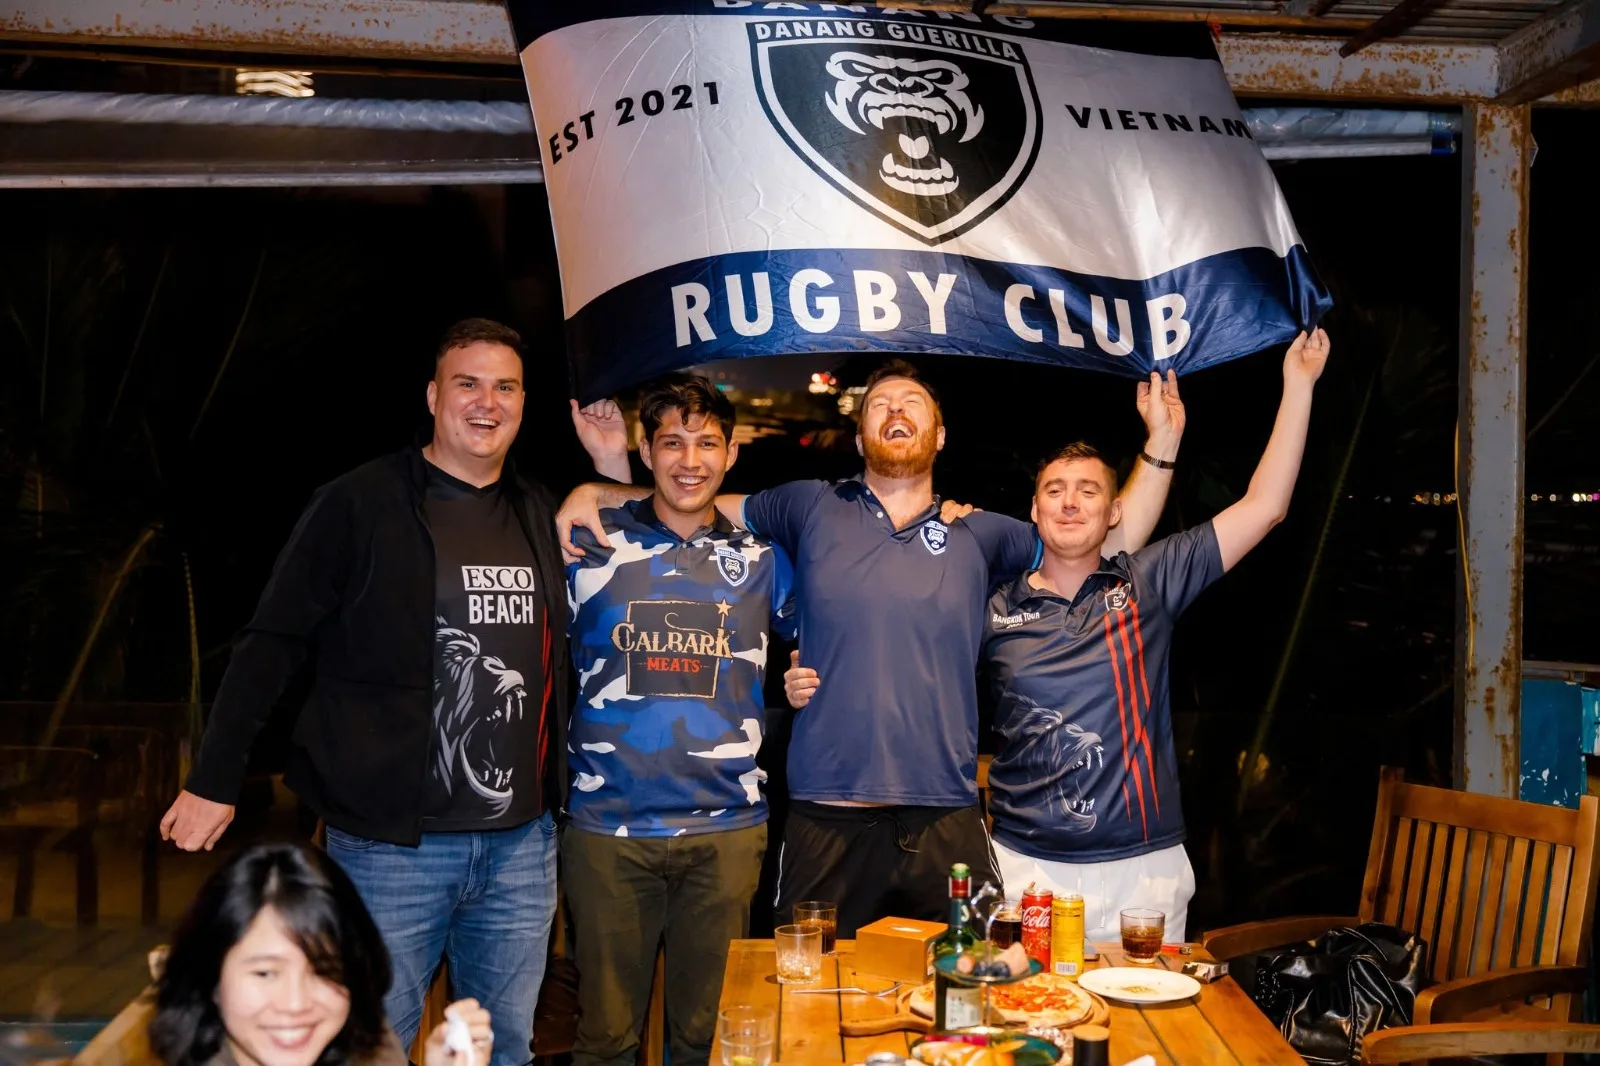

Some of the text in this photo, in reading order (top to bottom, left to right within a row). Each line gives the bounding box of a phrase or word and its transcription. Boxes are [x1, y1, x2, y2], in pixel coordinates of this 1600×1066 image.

[755, 21, 1021, 61] DANANG GUERILLA
[549, 82, 719, 165] EST 2021
[1065, 104, 1253, 140] VIETNAM
[671, 268, 1192, 361] RUGBY CLUB
[464, 568, 532, 589] ESCO
[468, 594, 534, 624] BEACH
[647, 657, 701, 673] MEATS
